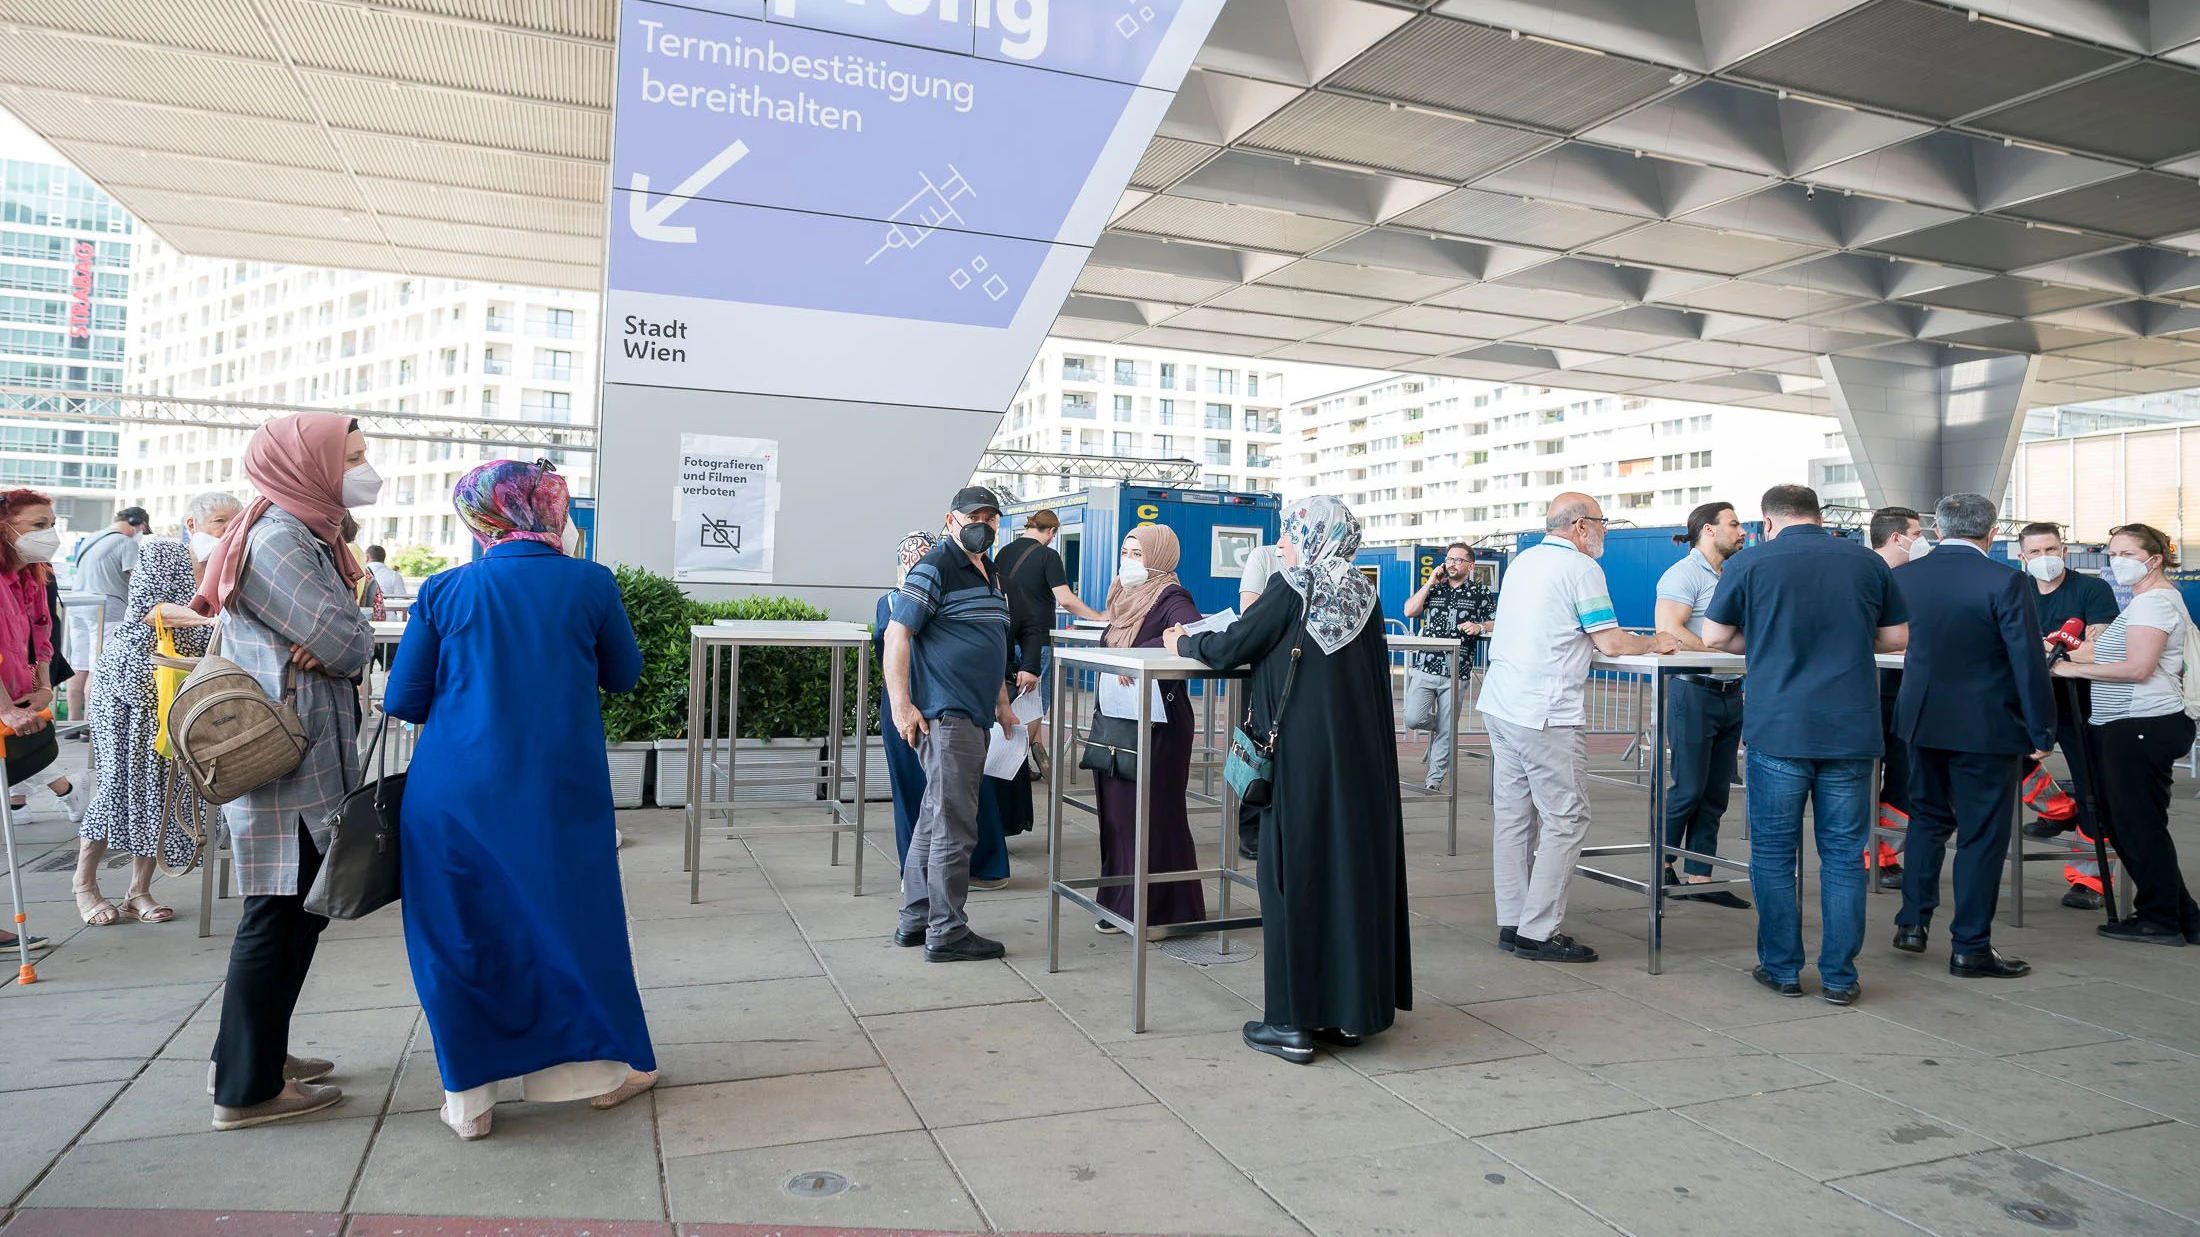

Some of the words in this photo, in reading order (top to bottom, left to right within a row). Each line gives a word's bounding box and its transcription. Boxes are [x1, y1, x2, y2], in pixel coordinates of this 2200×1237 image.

[638, 19, 975, 113] Terminbestätigung
[641, 67, 863, 132] bereithalten
[70, 241, 95, 339] STRABAG
[624, 315, 688, 339] Stadt
[623, 338, 686, 362] Wien
[684, 456, 764, 471] Fotografieren
[683, 472, 706, 481] und
[708, 472, 747, 483] Filmen
[682, 485, 736, 497] verboten
[2061, 631, 2081, 647] ORF
